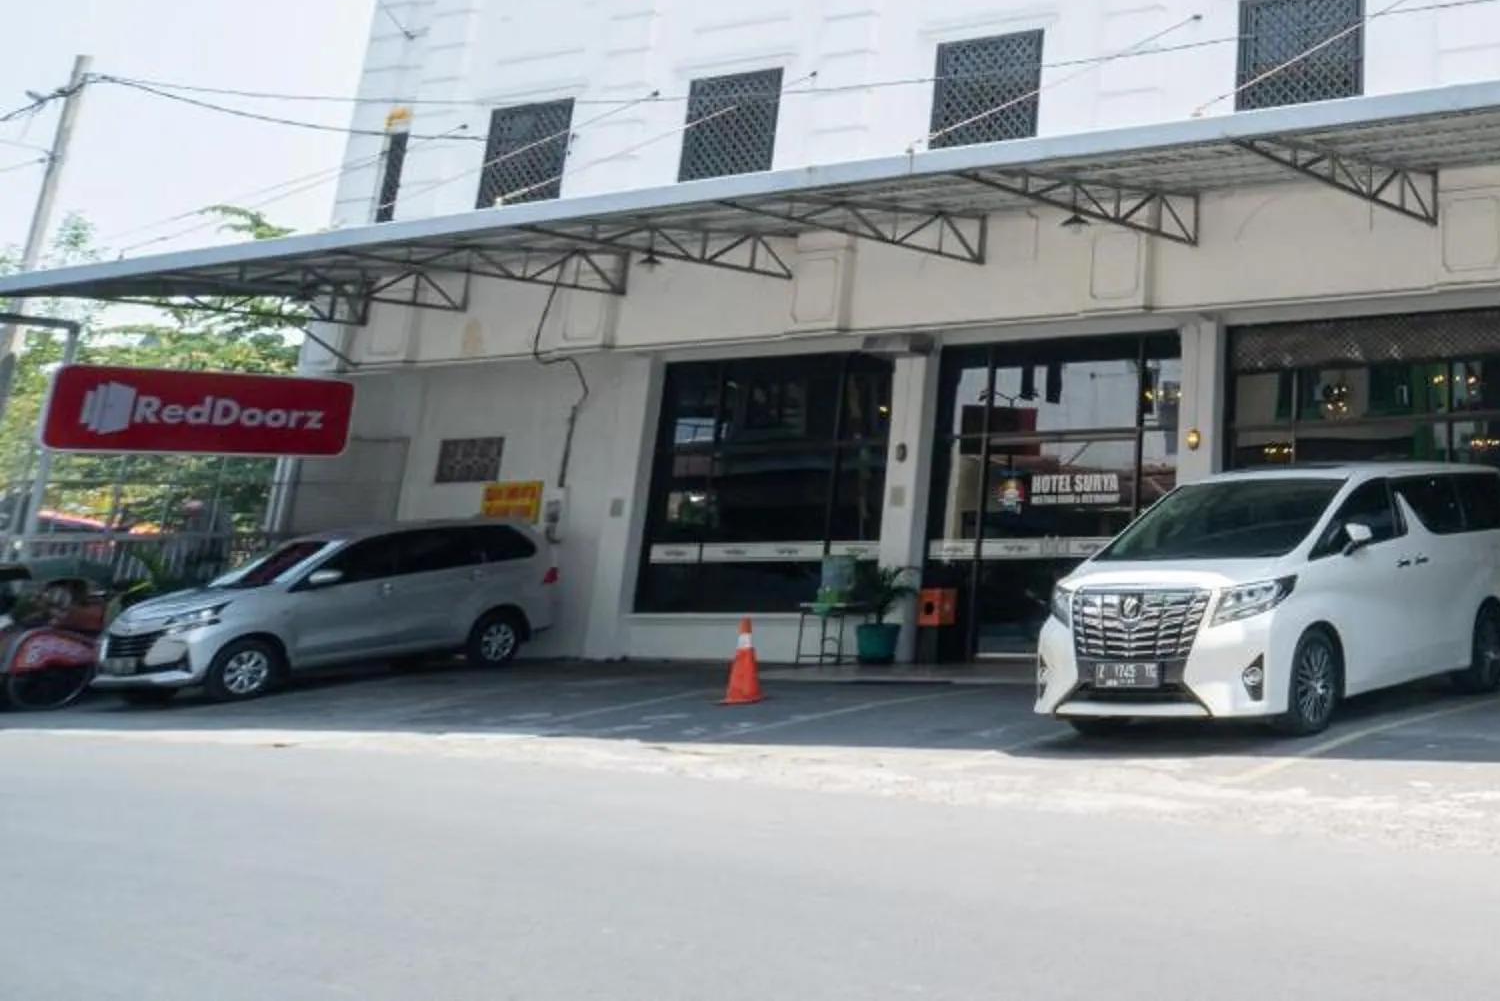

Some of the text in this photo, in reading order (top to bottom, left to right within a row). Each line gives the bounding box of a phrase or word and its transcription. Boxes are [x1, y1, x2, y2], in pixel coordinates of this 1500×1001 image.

[133, 395, 325, 430] RedDoorz
[1031, 472, 1119, 494] HOTEL SURYA
